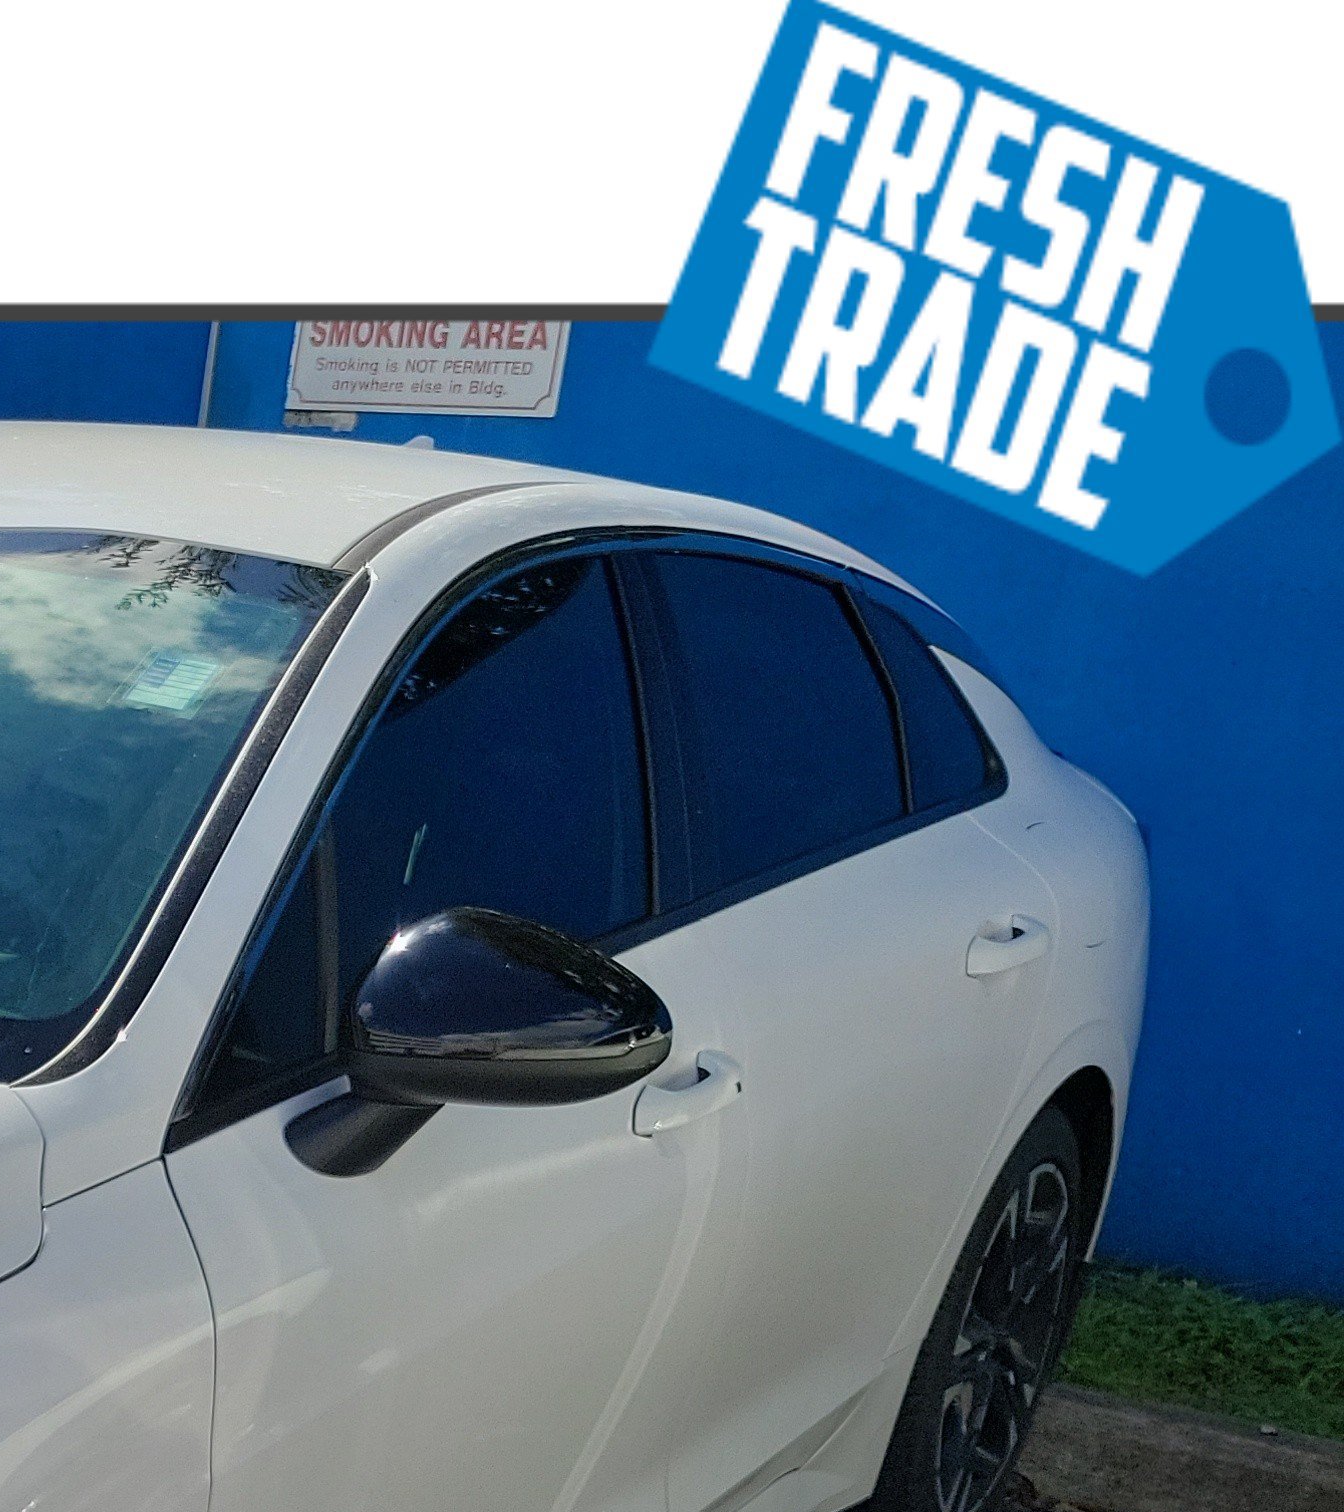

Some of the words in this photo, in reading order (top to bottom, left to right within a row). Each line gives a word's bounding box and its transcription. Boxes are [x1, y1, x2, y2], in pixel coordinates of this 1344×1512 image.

[310, 320, 450, 349] SMOKING
[460, 320, 548, 350] AREA
[315, 357, 379, 375] Smoking
[385, 359, 398, 373] is
[405, 359, 438, 374] NOT
[442, 360, 533, 375] PERMITTED
[332, 379, 404, 393] anywhere
[410, 379, 443, 394] else
[449, 380, 462, 394] in
